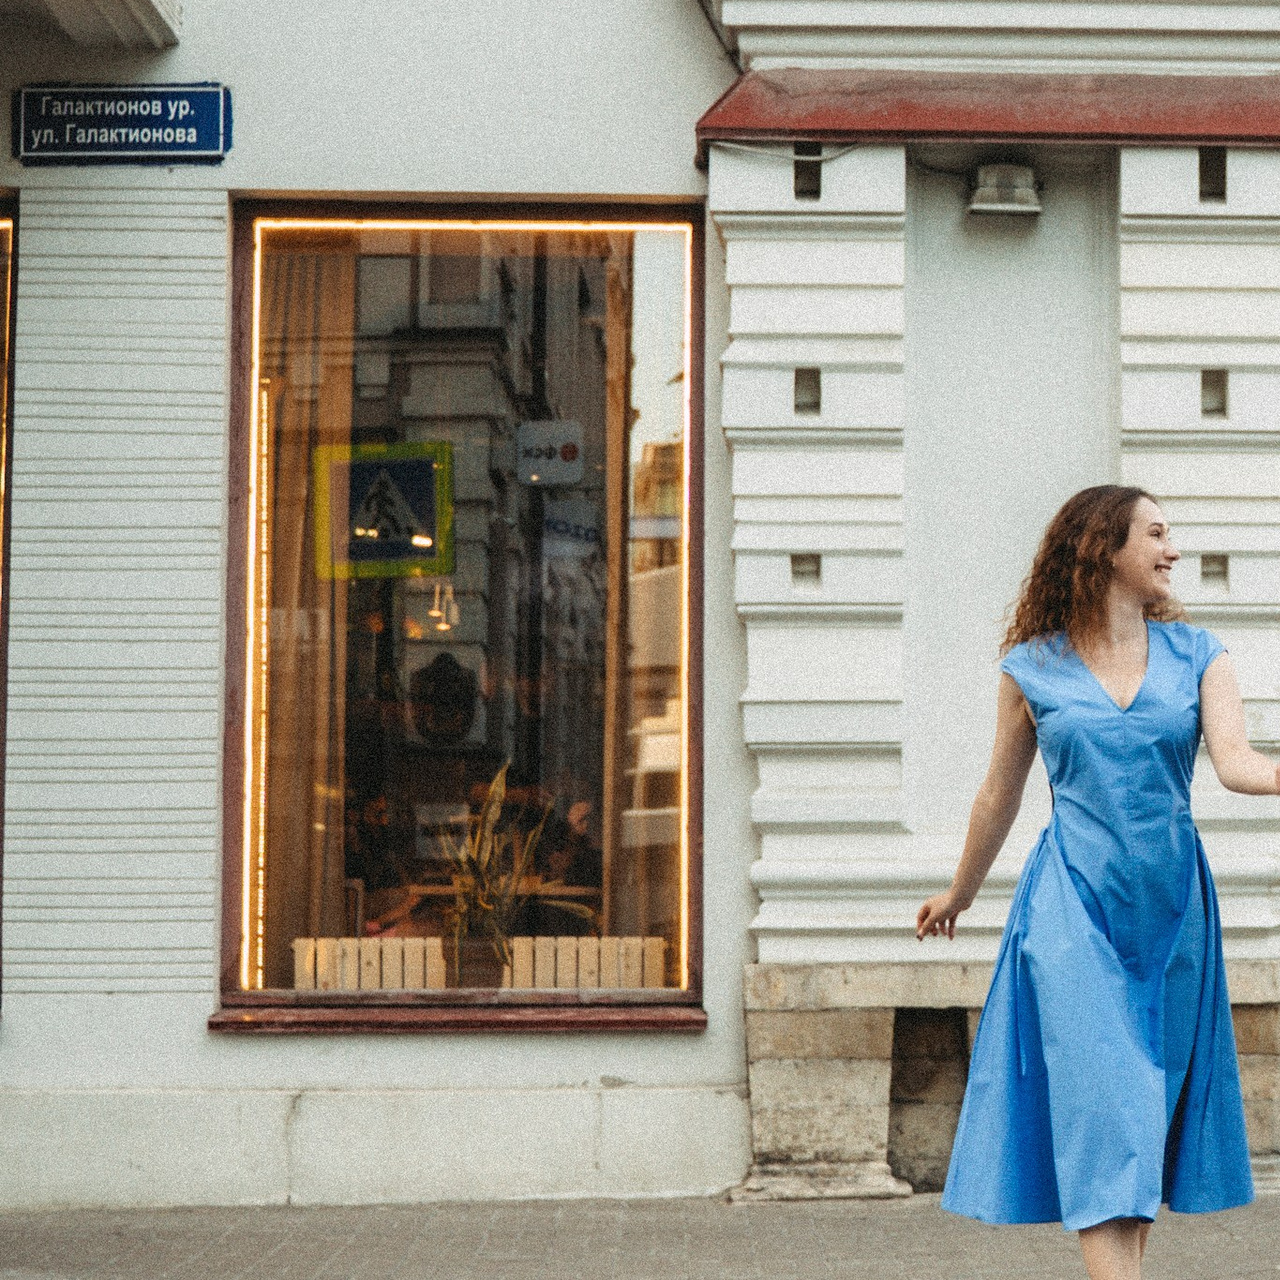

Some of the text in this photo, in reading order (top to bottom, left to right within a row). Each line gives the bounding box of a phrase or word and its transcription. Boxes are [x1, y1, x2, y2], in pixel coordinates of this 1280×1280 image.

[42, 96, 195, 120] Галактионов ур.
[31, 124, 197, 149] ул. Галактионова
